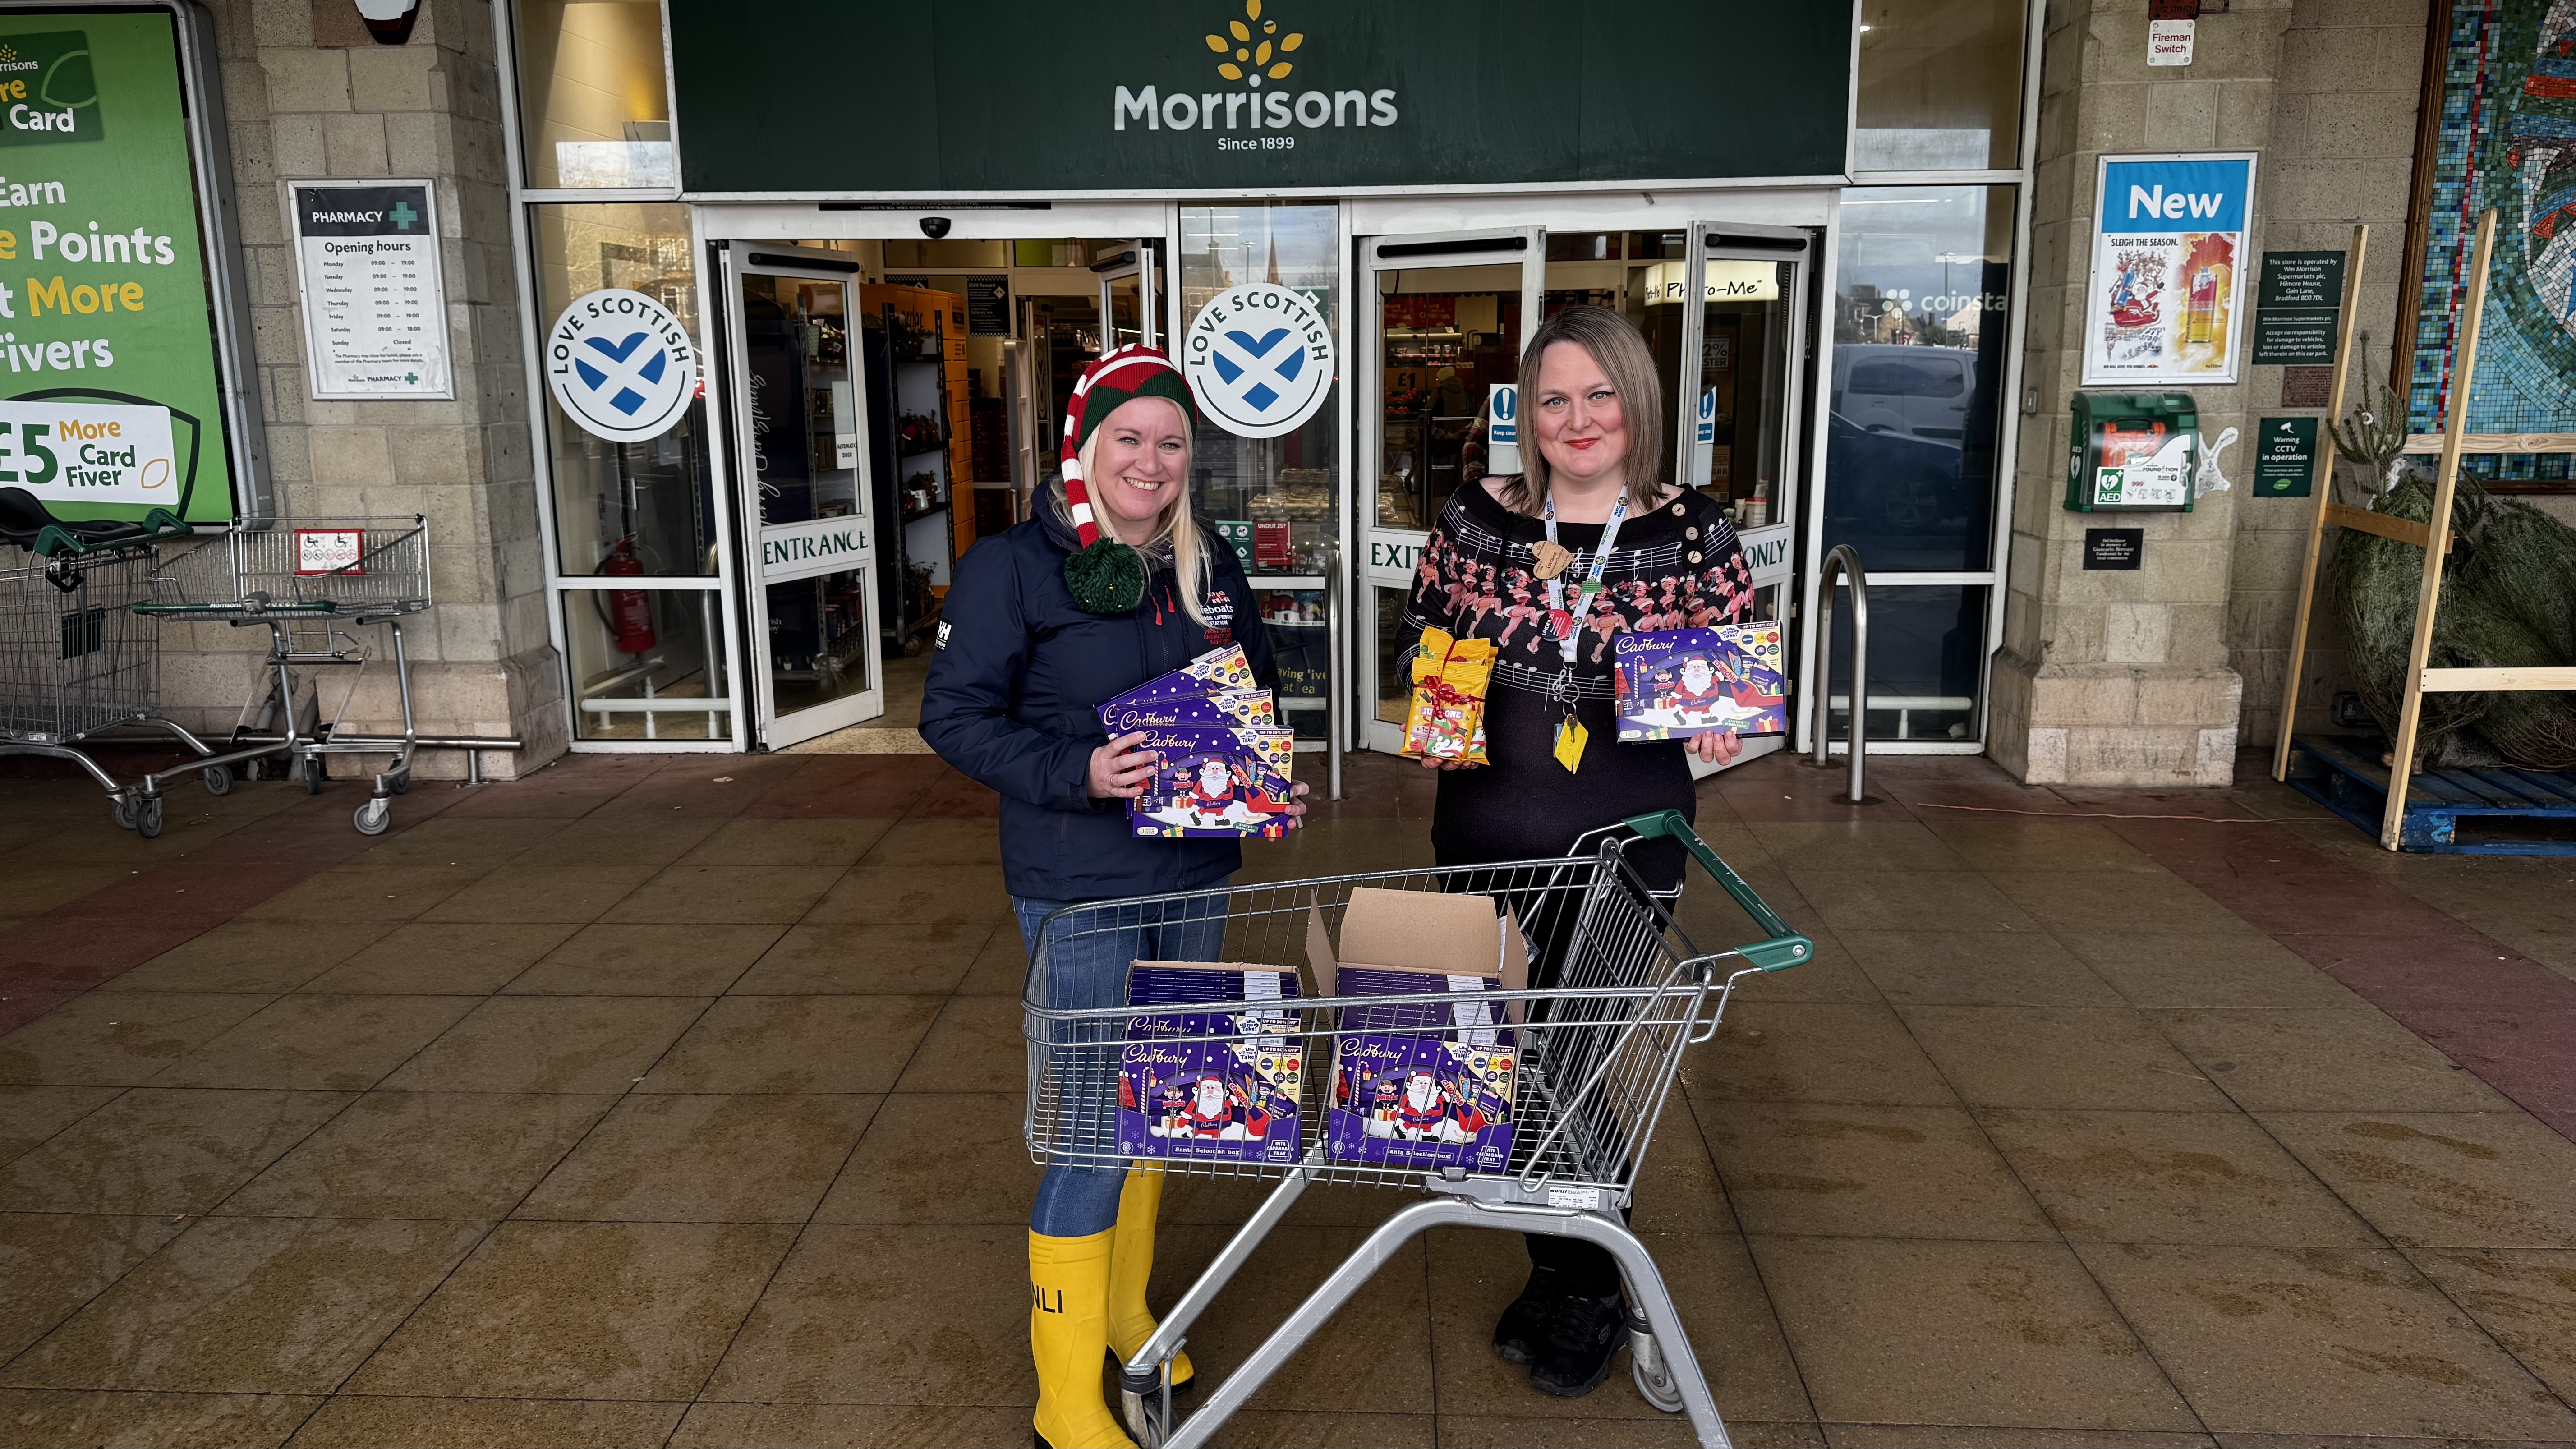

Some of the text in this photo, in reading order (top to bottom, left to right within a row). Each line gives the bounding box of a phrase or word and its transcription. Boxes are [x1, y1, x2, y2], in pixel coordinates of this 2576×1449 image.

[2153, 33, 2191, 41] Fireman
[2155, 45, 2186, 53] Switch
[0, 60, 38, 71] rrisons
[1114, 74, 1398, 130] Morrisons
[10, 104, 75, 132] Card
[1218, 137, 1295, 150] Since 1899
[0, 177, 66, 207] Earn
[2129, 184, 2223, 220] New
[312, 211, 383, 223] PHARMACY
[31, 221, 175, 265] Points
[325, 240, 411, 256] Opening hours
[27, 276, 144, 316] More
[1921, 290, 2008, 311] coinsta
[554, 298, 690, 374] LOVE SCOTTISH
[1190, 291, 1328, 365] LOVE SCOTTISH
[59, 419, 121, 442] More
[80, 444, 136, 467] Card
[2271, 453, 2308, 462] operation
[65, 465, 122, 487] Fiver
[2099, 493, 2120, 501] AED
[763, 529, 868, 566] ENTRANCE
[1744, 538, 1787, 570] ONLY
[1615, 636, 1674, 655] Cadbury
[1278, 667, 1304, 682] aving
[1714, 660, 1738, 683] crunchie
[1283, 683, 1294, 692] at
[1444, 708, 1462, 718] ONE
[1139, 730, 1196, 752] Cadbury
[1231, 764, 1251, 789] crunchie
[1241, 1023, 1259, 1032] Take?
[1122, 1043, 1188, 1069] Cadbury
[1339, 1038, 1403, 1064] Cadbury
[1032, 1281, 1063, 1314] NLI
